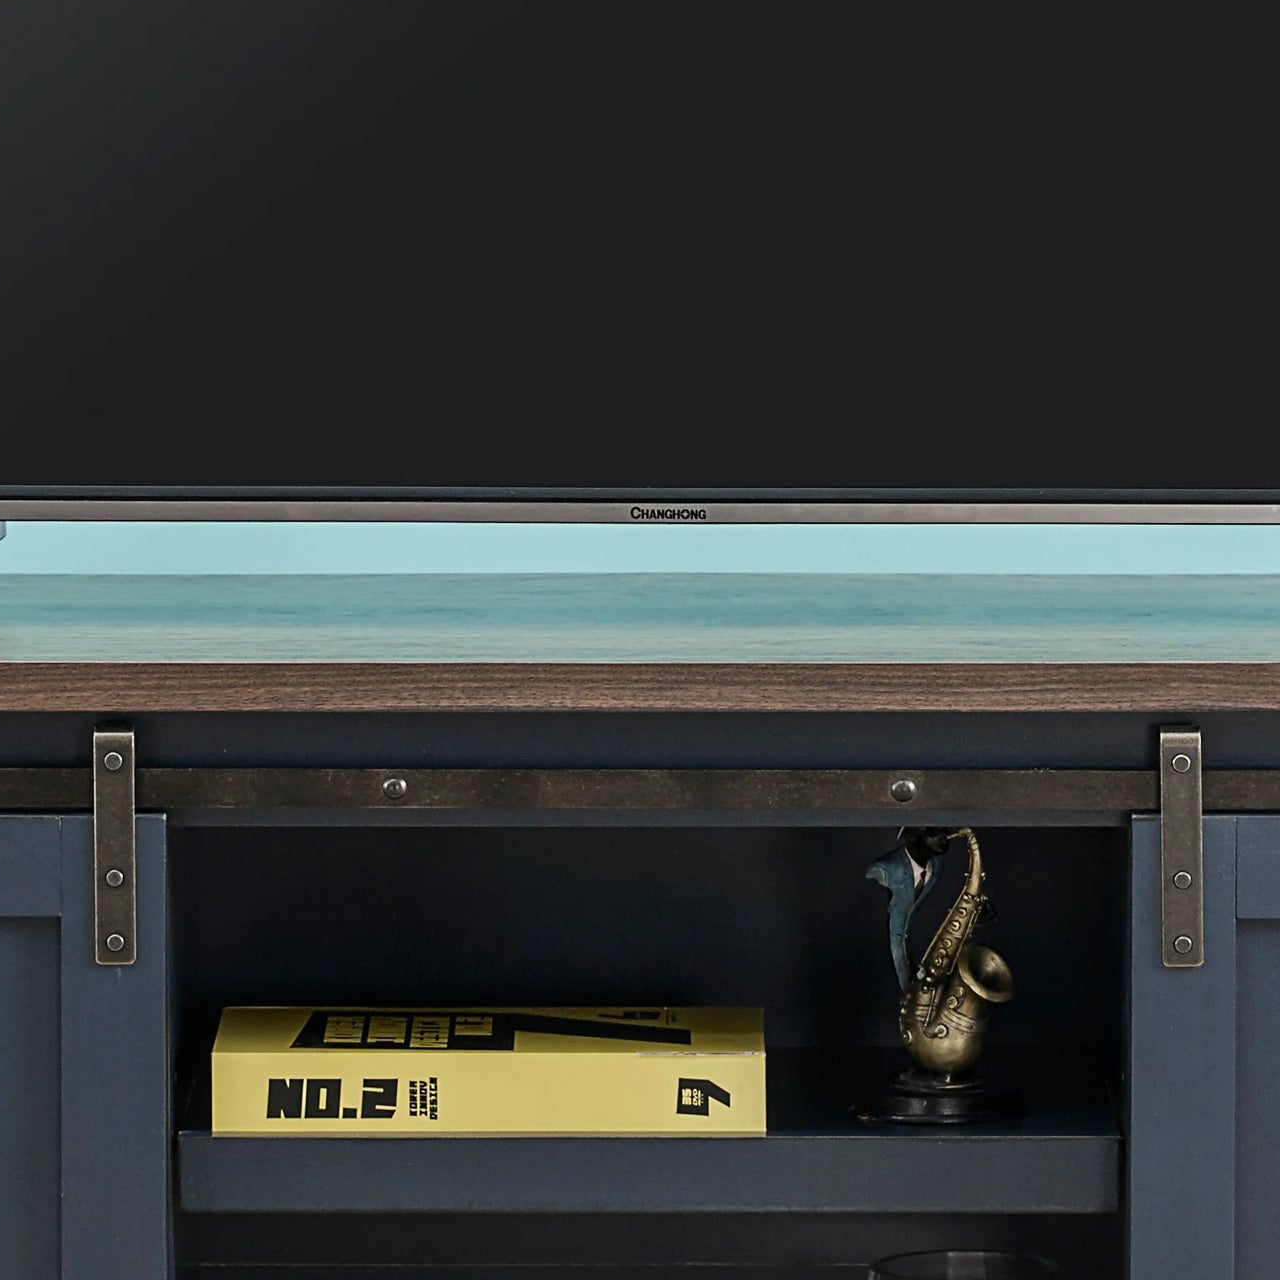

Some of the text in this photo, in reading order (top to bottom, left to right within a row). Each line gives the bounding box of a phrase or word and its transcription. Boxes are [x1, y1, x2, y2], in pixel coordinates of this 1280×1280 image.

[630, 506, 707, 520] CHANGHONG
[266, 1078, 399, 1119] NO.2
[409, 1080, 418, 1117] KOREA
[419, 1080, 428, 1117] INNOV
[429, 1077, 438, 1120] DESIGN
